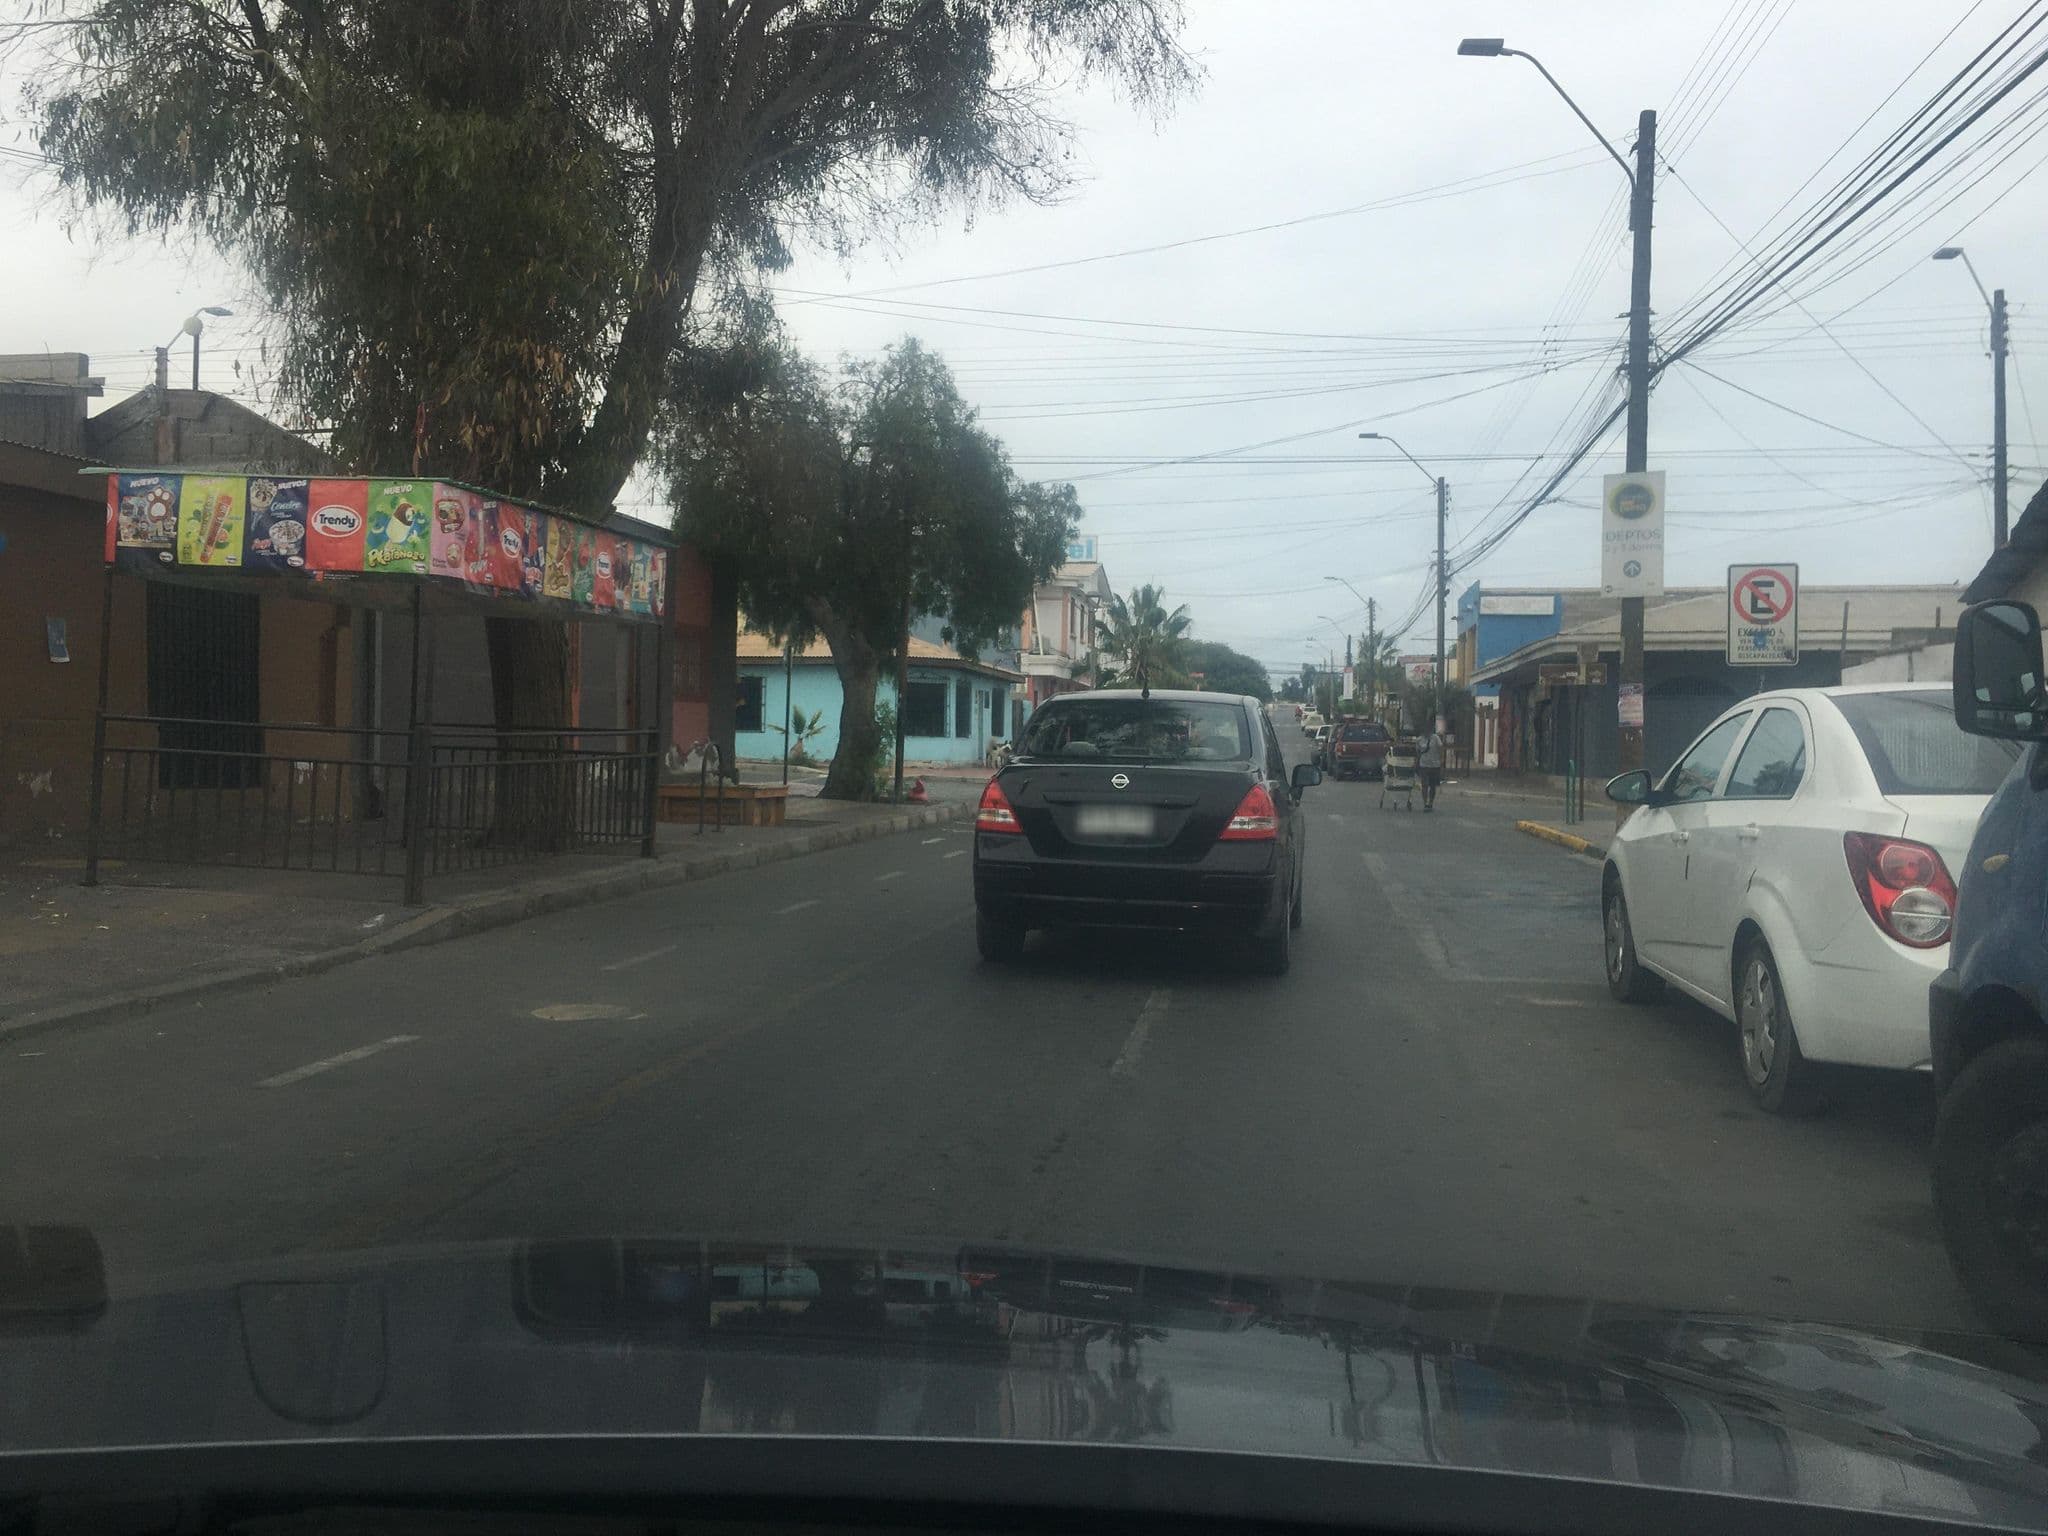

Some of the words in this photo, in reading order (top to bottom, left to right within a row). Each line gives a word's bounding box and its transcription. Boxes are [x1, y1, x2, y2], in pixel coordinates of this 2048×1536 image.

[383, 484, 413, 496] NUEVO
[318, 513, 357, 528] Trendy
[1605, 527, 1662, 542] DEPTOS
[1737, 627, 1776, 637] EXCO
